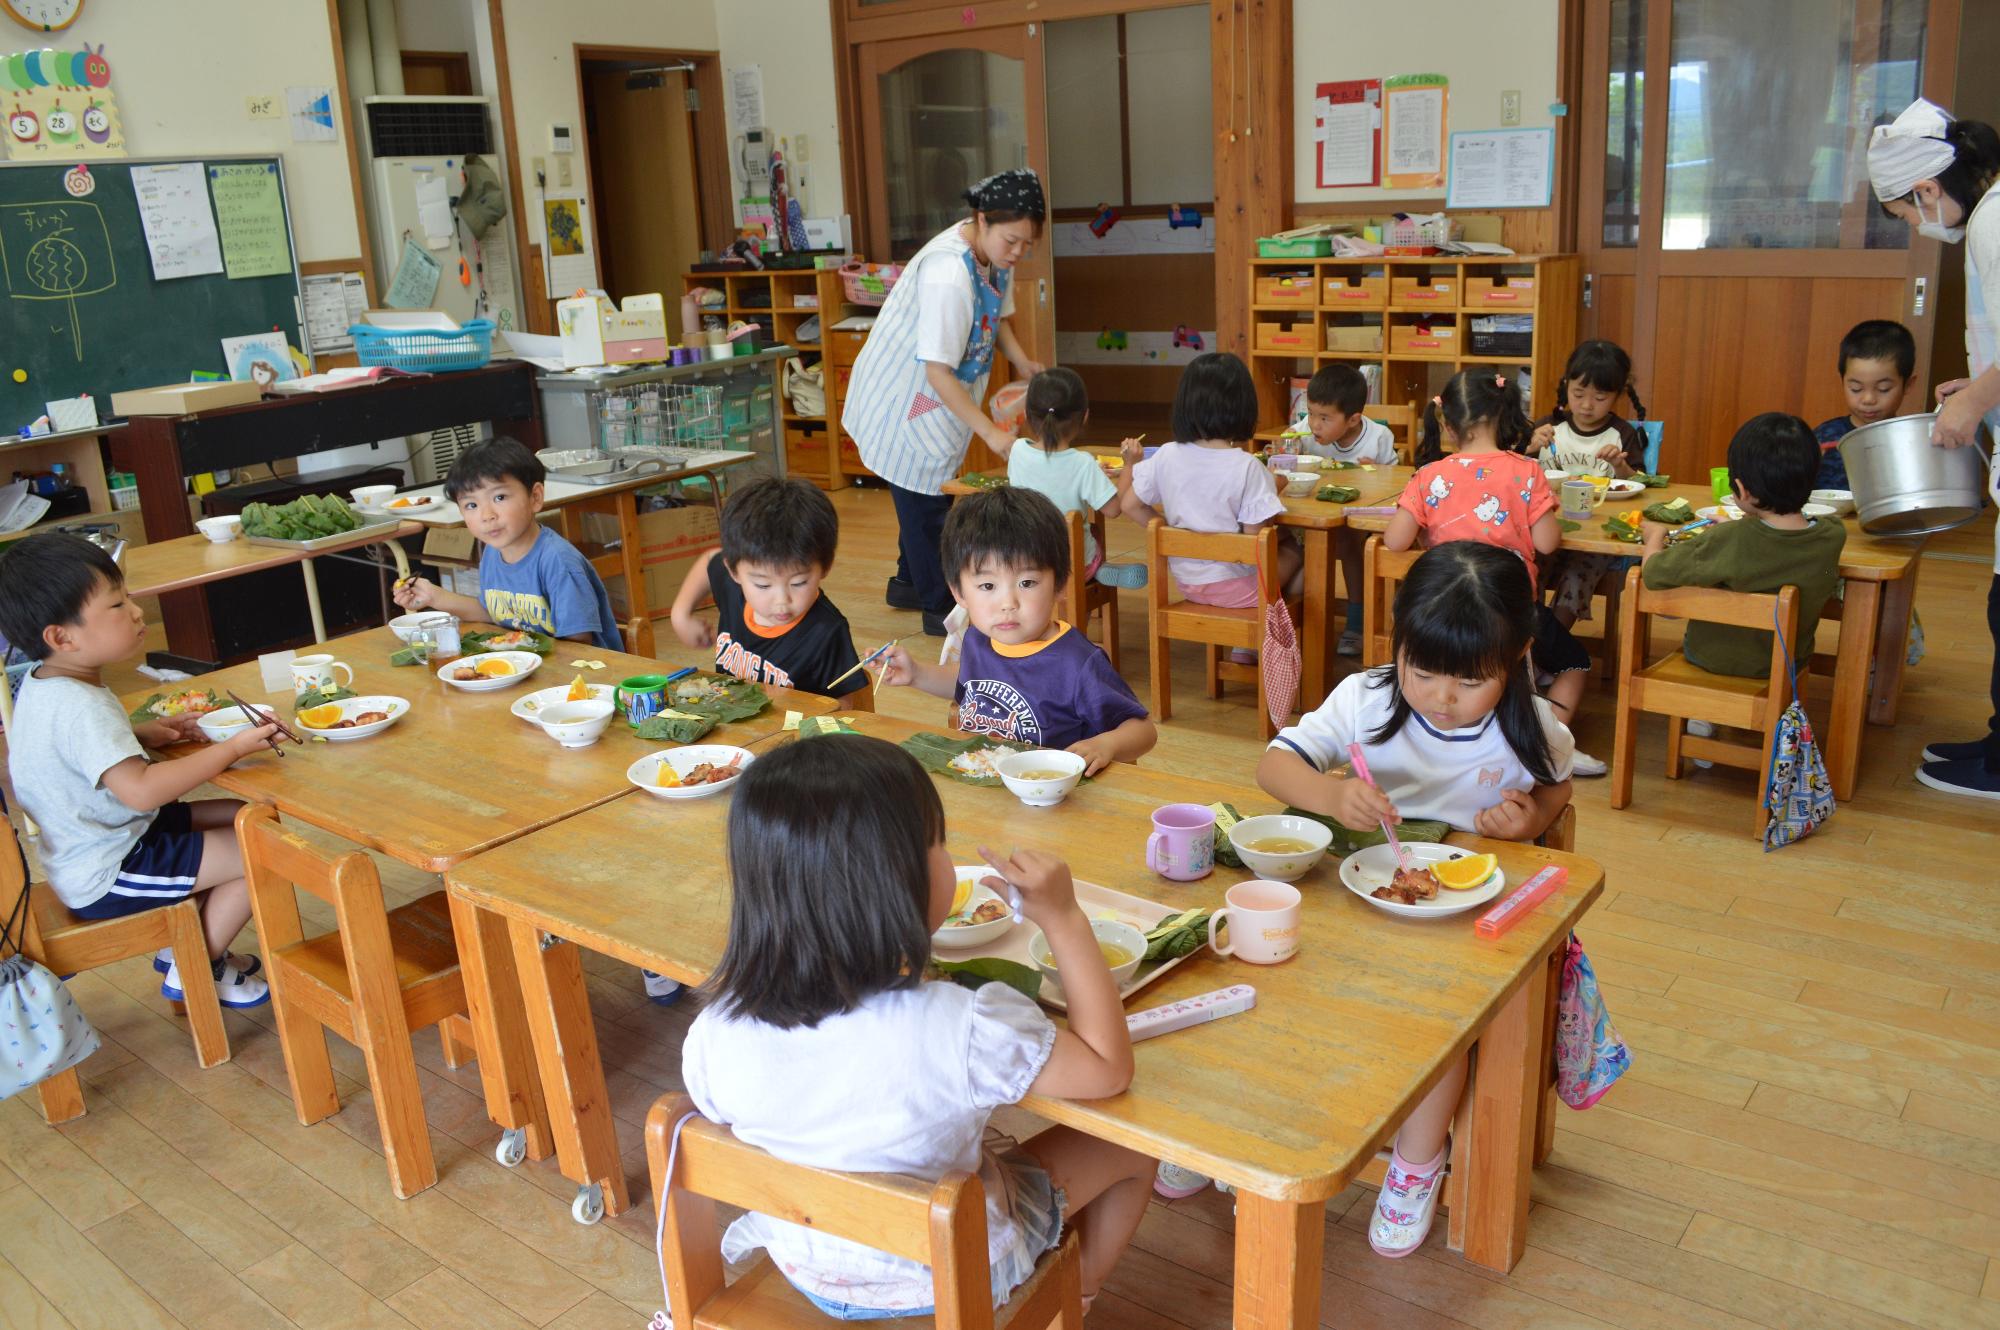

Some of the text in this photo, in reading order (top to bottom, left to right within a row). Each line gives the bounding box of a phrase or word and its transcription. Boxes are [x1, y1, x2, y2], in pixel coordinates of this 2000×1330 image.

[18, 120, 28, 133] 5
[51, 117, 66, 129] 28
[960, 700, 1017, 733] Beyond
